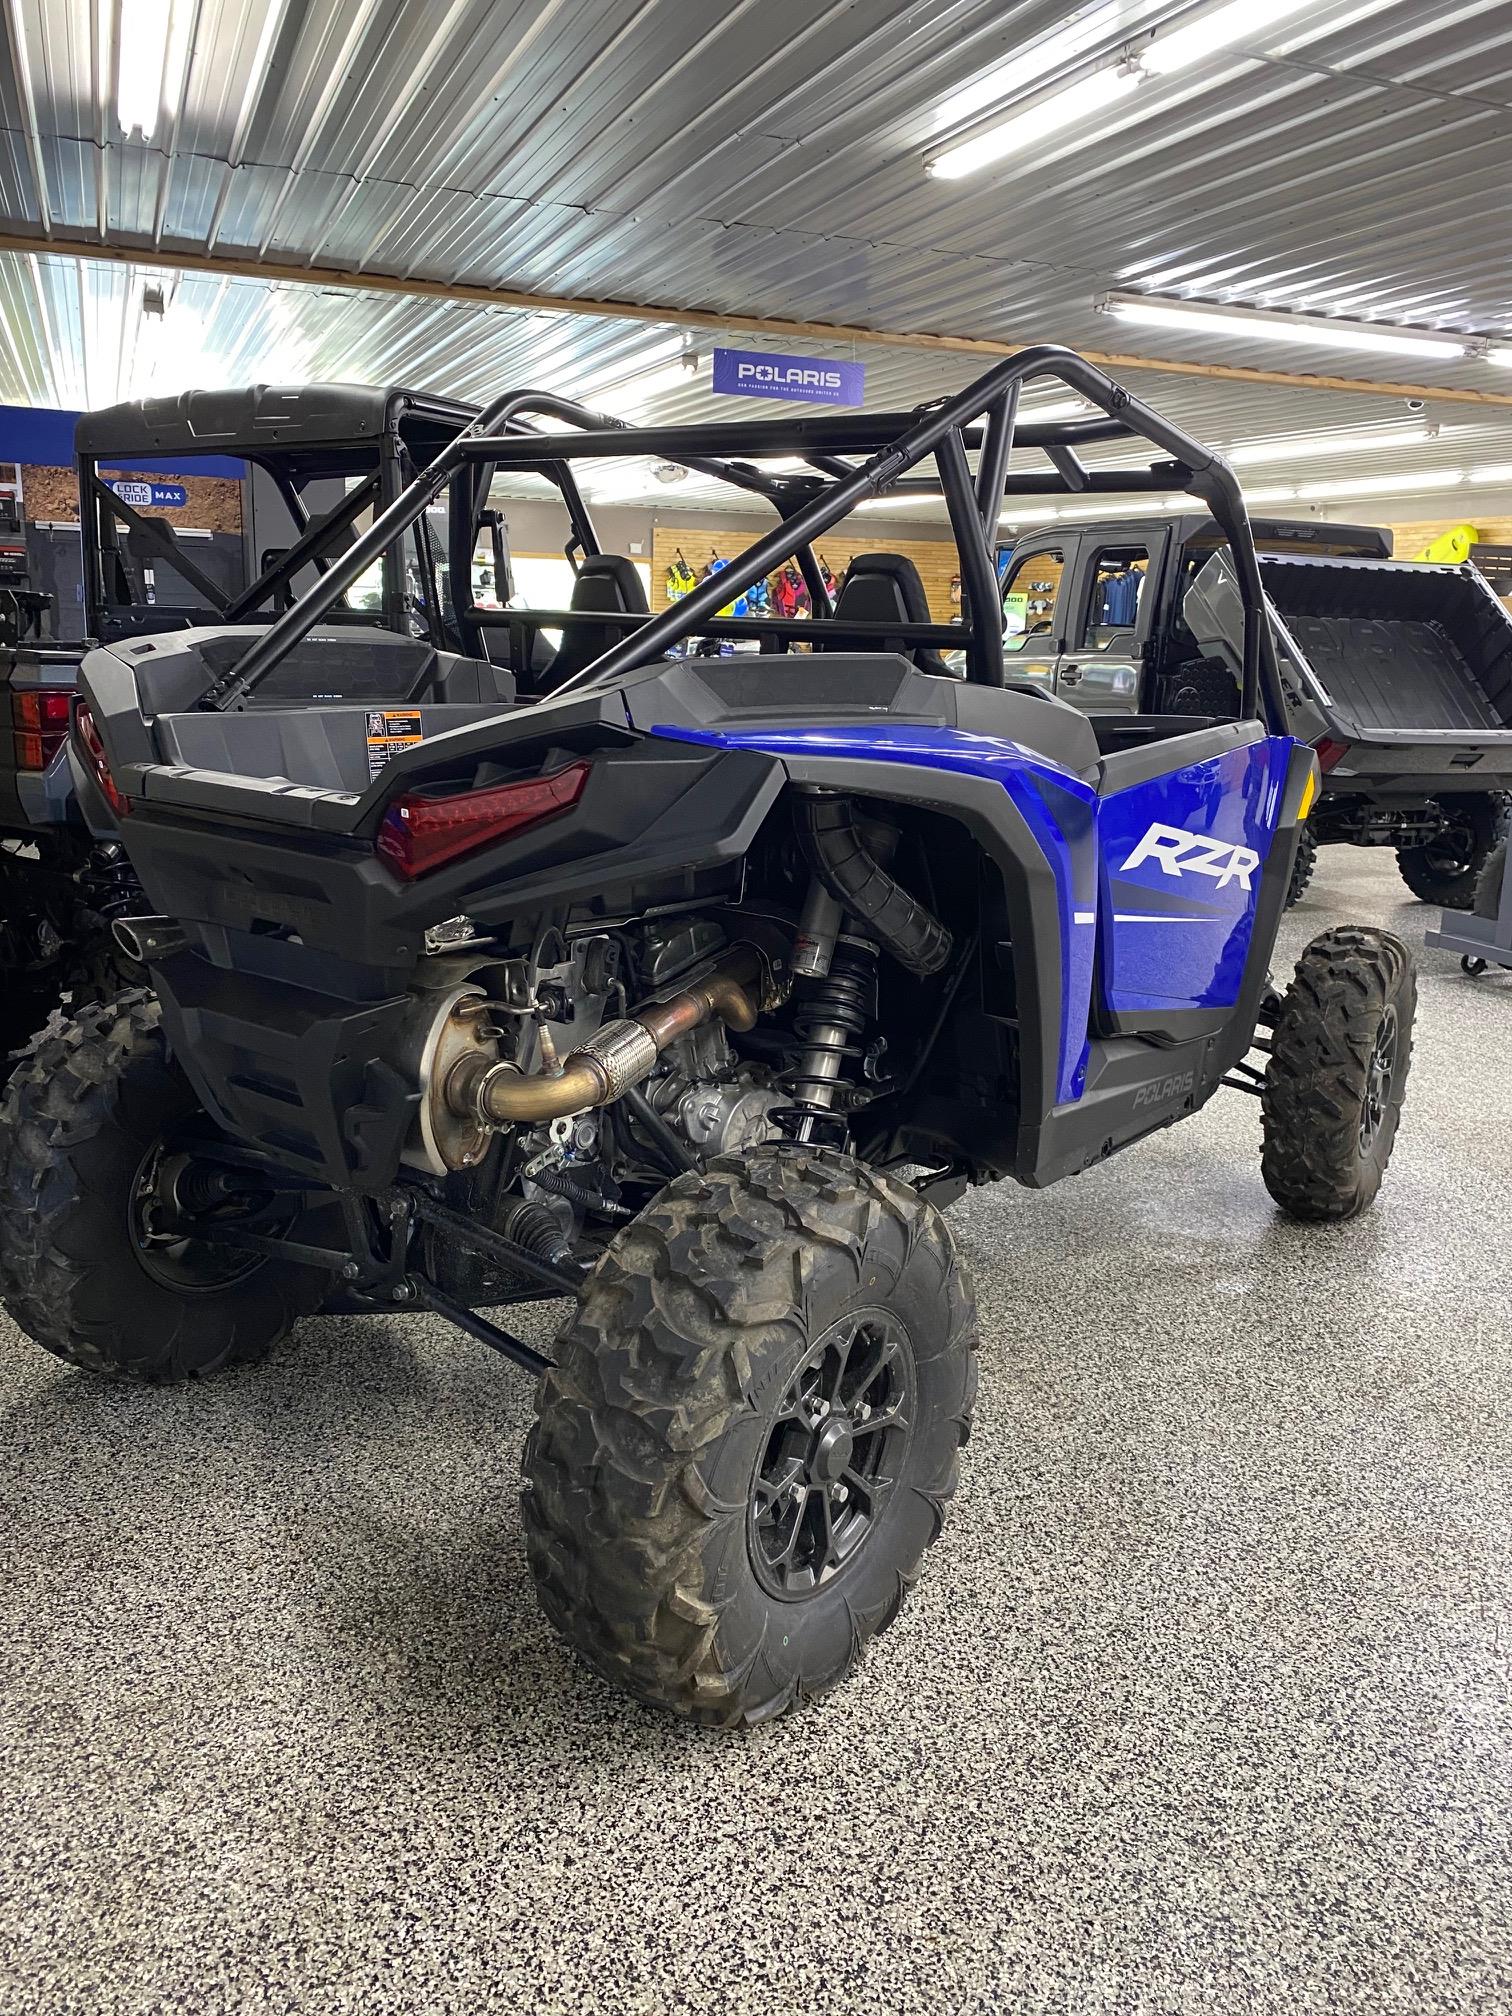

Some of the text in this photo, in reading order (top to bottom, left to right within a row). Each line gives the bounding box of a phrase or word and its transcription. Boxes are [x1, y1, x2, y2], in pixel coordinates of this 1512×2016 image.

[738, 363, 841, 388] POLARIS
[117, 484, 148, 494] LOCK
[155, 491, 181, 500] MAX
[1118, 822, 1261, 892] RZR
[1132, 1070, 1194, 1110] POLARIS
